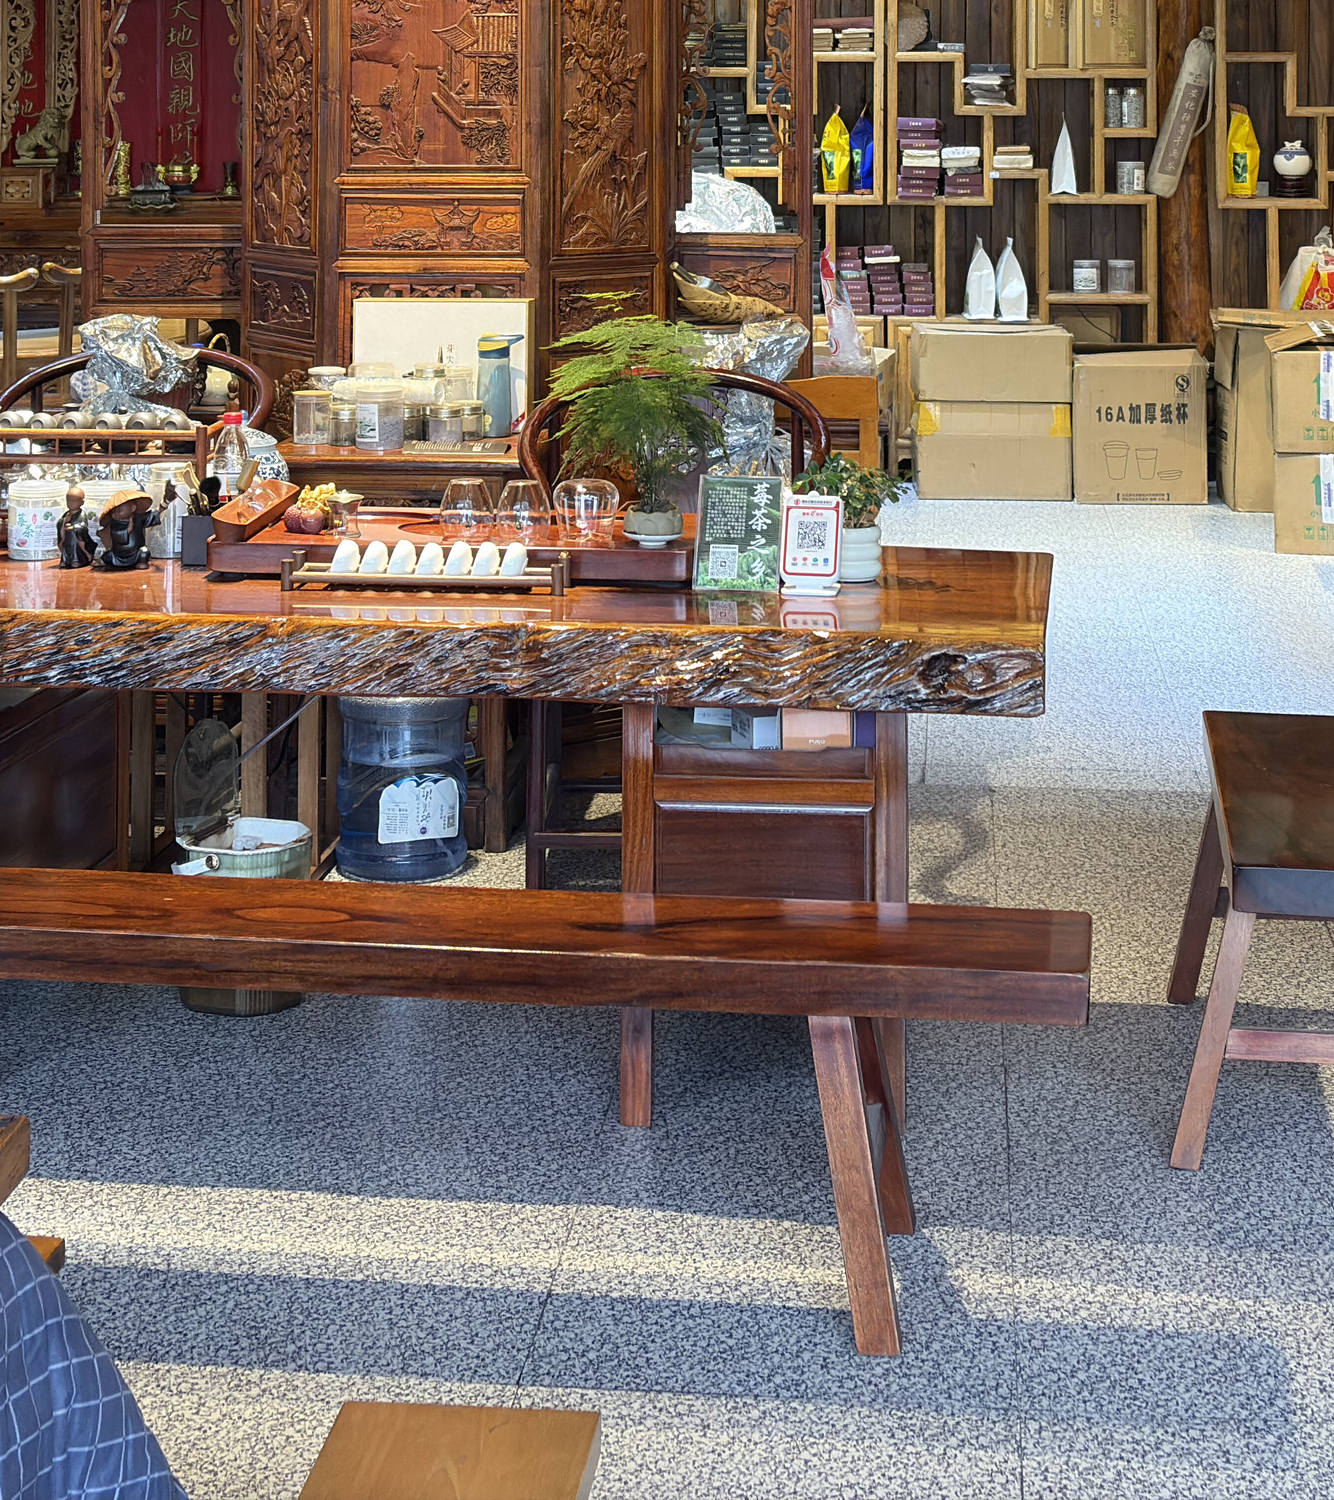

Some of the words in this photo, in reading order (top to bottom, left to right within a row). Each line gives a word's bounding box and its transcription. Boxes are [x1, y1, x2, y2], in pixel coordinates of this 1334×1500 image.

[1096, 403, 1189, 425] 16A加厚纸杯
[747, 482, 773, 580] 莓茶之乡
